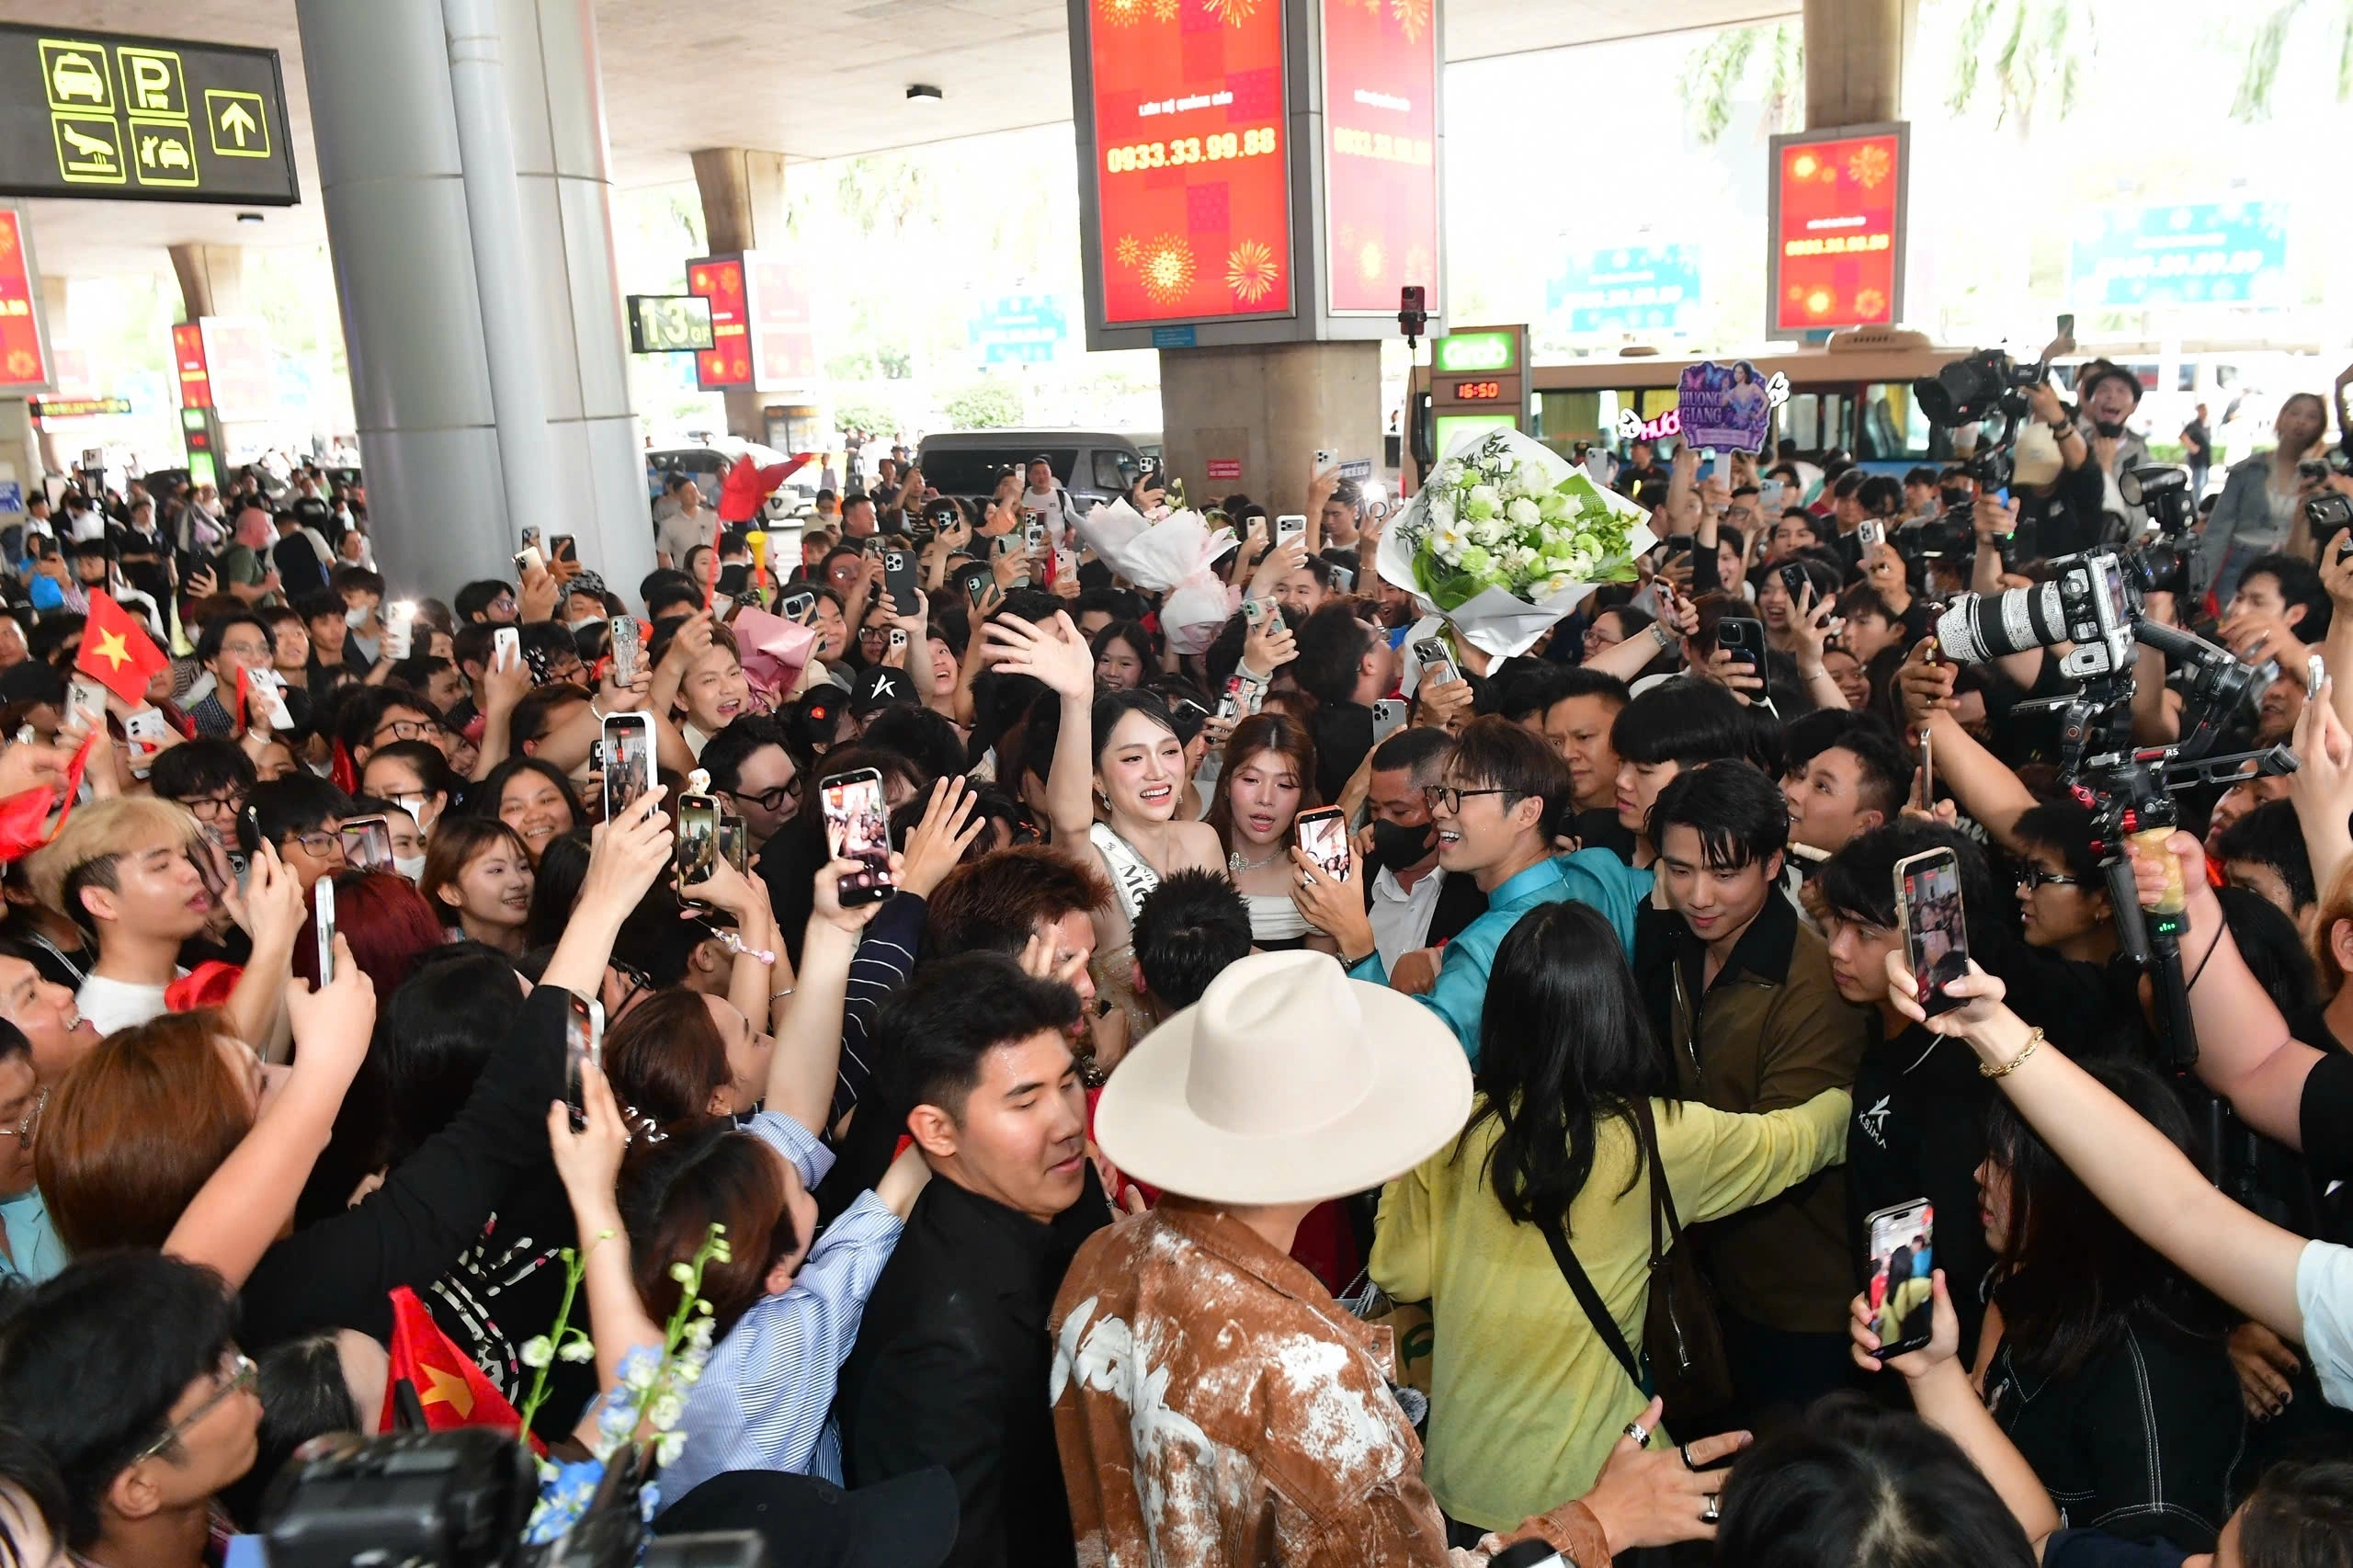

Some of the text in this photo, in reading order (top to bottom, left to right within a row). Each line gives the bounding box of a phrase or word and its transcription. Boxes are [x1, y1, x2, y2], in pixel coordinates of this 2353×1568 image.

[1108, 127, 1276, 173] 0933.33.99.88
[640, 299, 688, 343] 13
[1459, 382, 1499, 399] 16:50
[1682, 407, 1722, 423] GIANG
